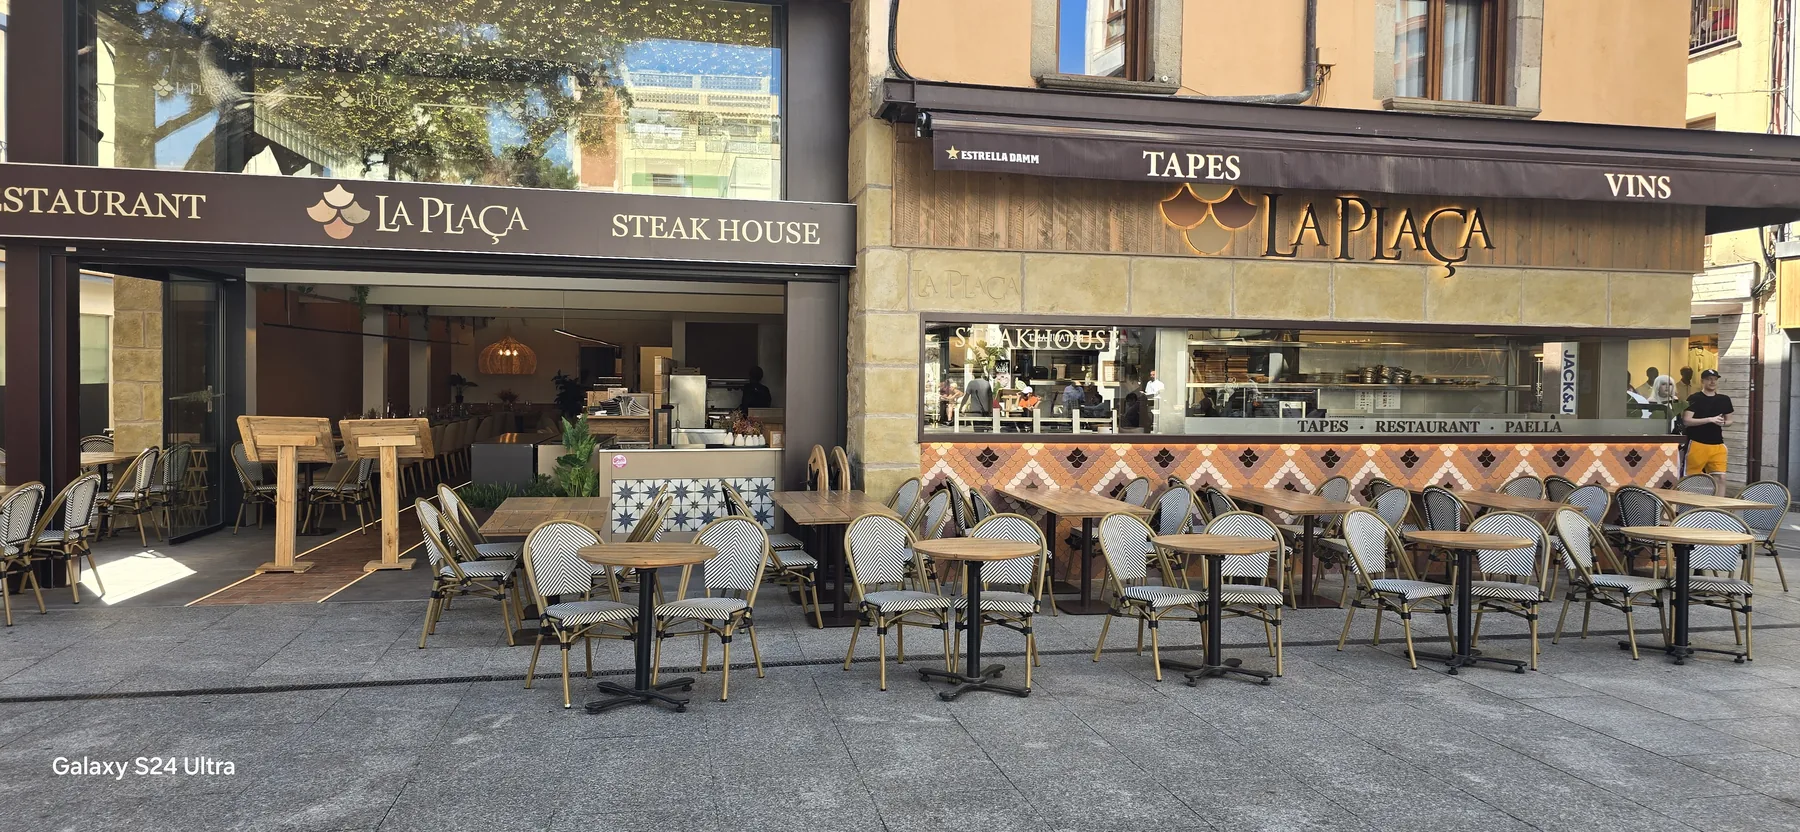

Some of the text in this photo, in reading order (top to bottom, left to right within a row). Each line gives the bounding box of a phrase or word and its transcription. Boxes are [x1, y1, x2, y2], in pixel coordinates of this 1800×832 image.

[961, 150, 1040, 164] ESTRELLA DAMM
[1142, 150, 1241, 181] TAPES
[1604, 173, 1672, 199] VINS
[0, 186, 206, 219] STAURANT
[375, 195, 529, 245] LA PLAÇA
[611, 213, 821, 246] STEAK HOUSE
[1260, 193, 1496, 279] LA PLAÇA
[955, 326, 1120, 350] STEAKHOUSE
[1562, 349, 1575, 415] JACK&J
[1297, 420, 1562, 433] TAPES RESTAURANT PAELLA
